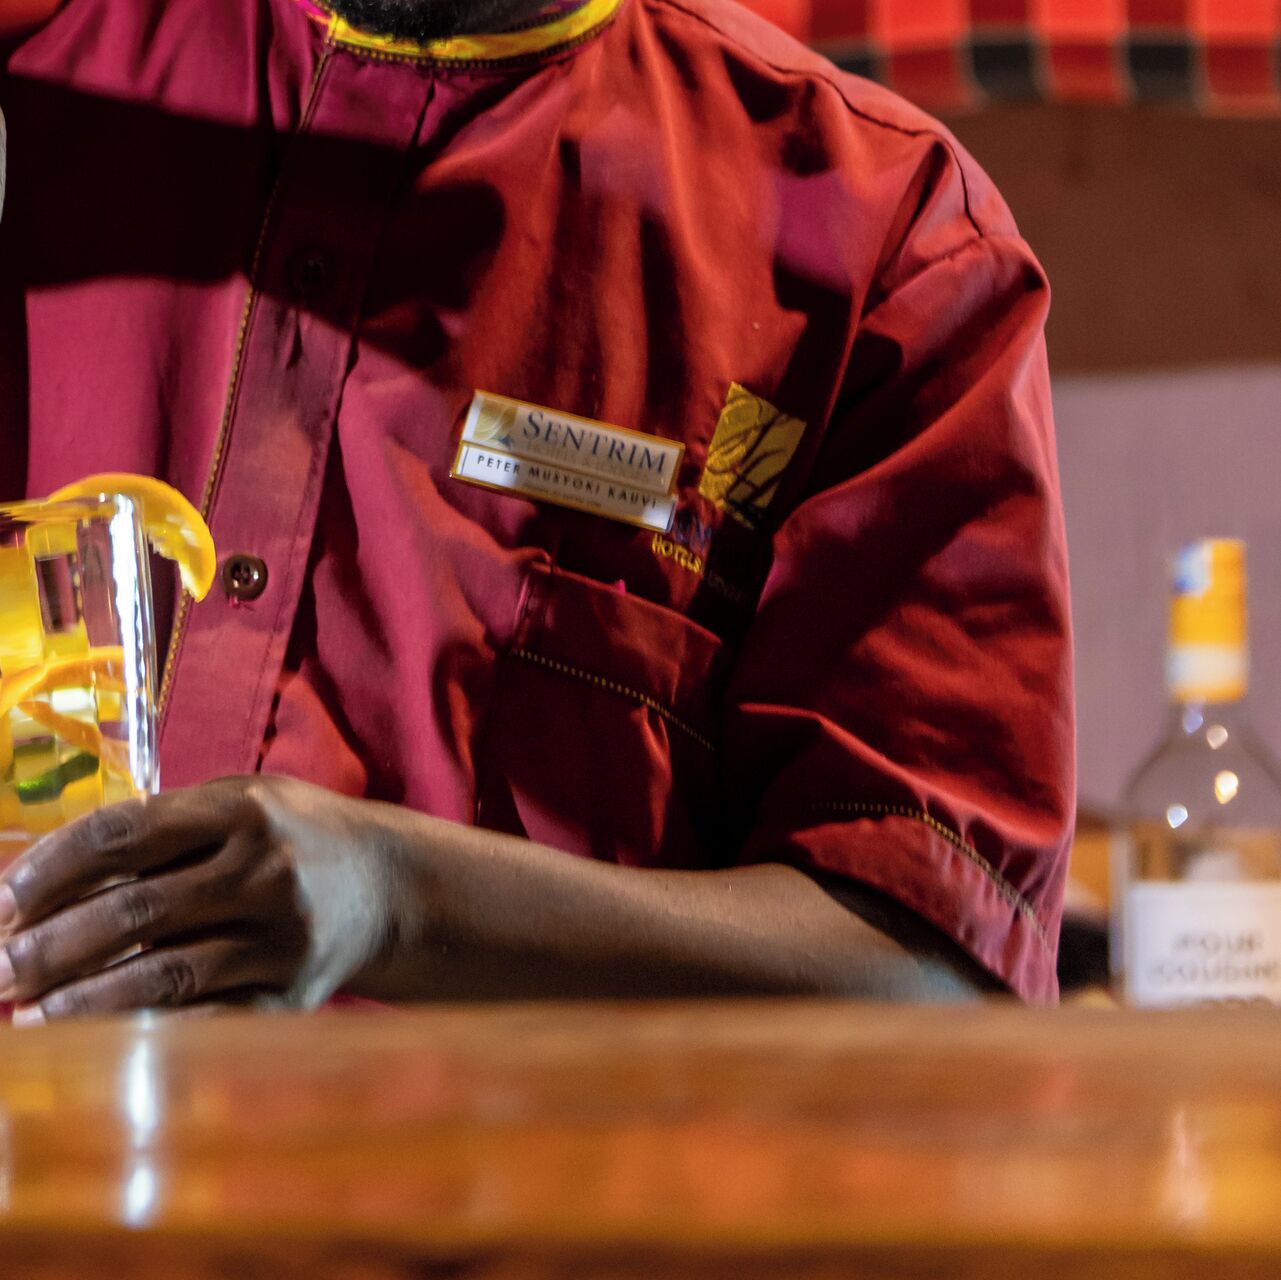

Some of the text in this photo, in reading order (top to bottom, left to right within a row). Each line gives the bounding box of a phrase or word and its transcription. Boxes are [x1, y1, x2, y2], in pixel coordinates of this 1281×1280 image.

[523, 410, 666, 475] SENTRIM
[477, 455, 520, 476] PETER
[528, 467, 600, 496] MUSYOKI
[608, 486, 657, 509] KAUVI
[651, 532, 702, 574] HOTELS
